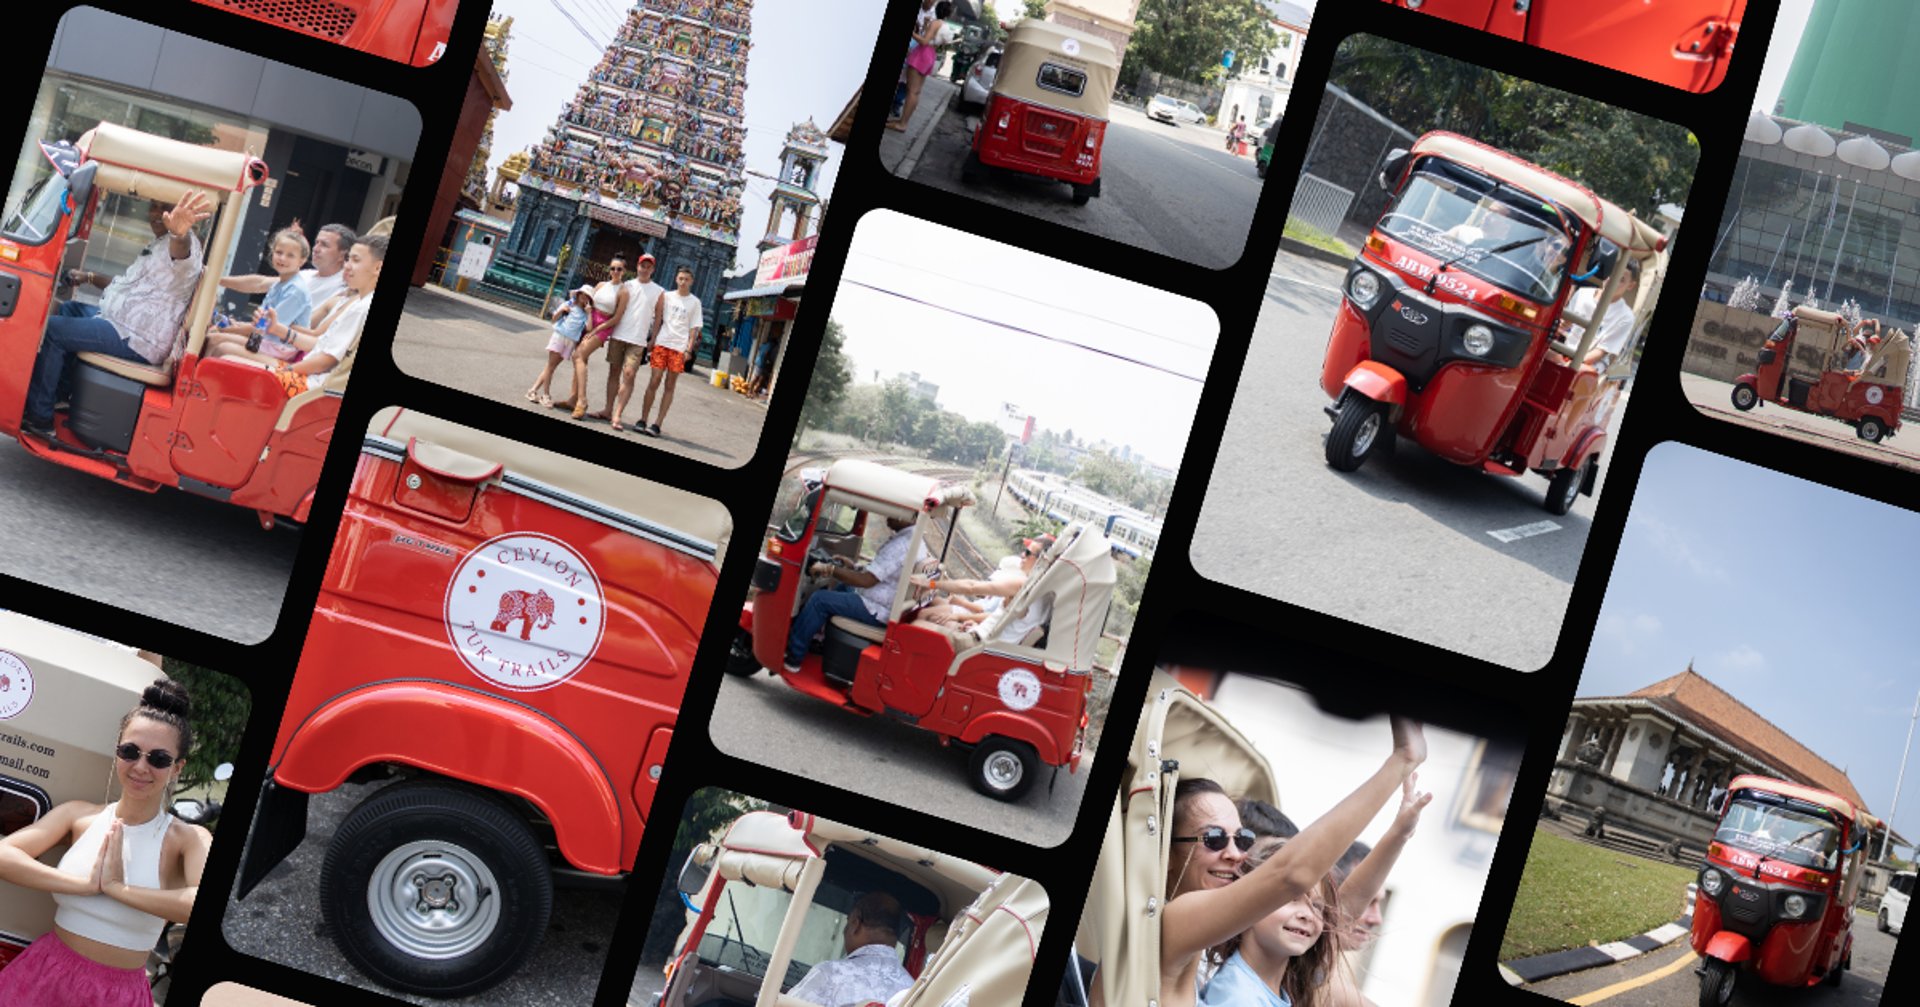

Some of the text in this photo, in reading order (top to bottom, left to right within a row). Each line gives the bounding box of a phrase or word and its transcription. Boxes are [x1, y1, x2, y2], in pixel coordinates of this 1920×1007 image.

[497, 547, 582, 588] CEYLON
[462, 620, 571, 678] TUK TRAILS
[0, 733, 56, 757] rails.com
